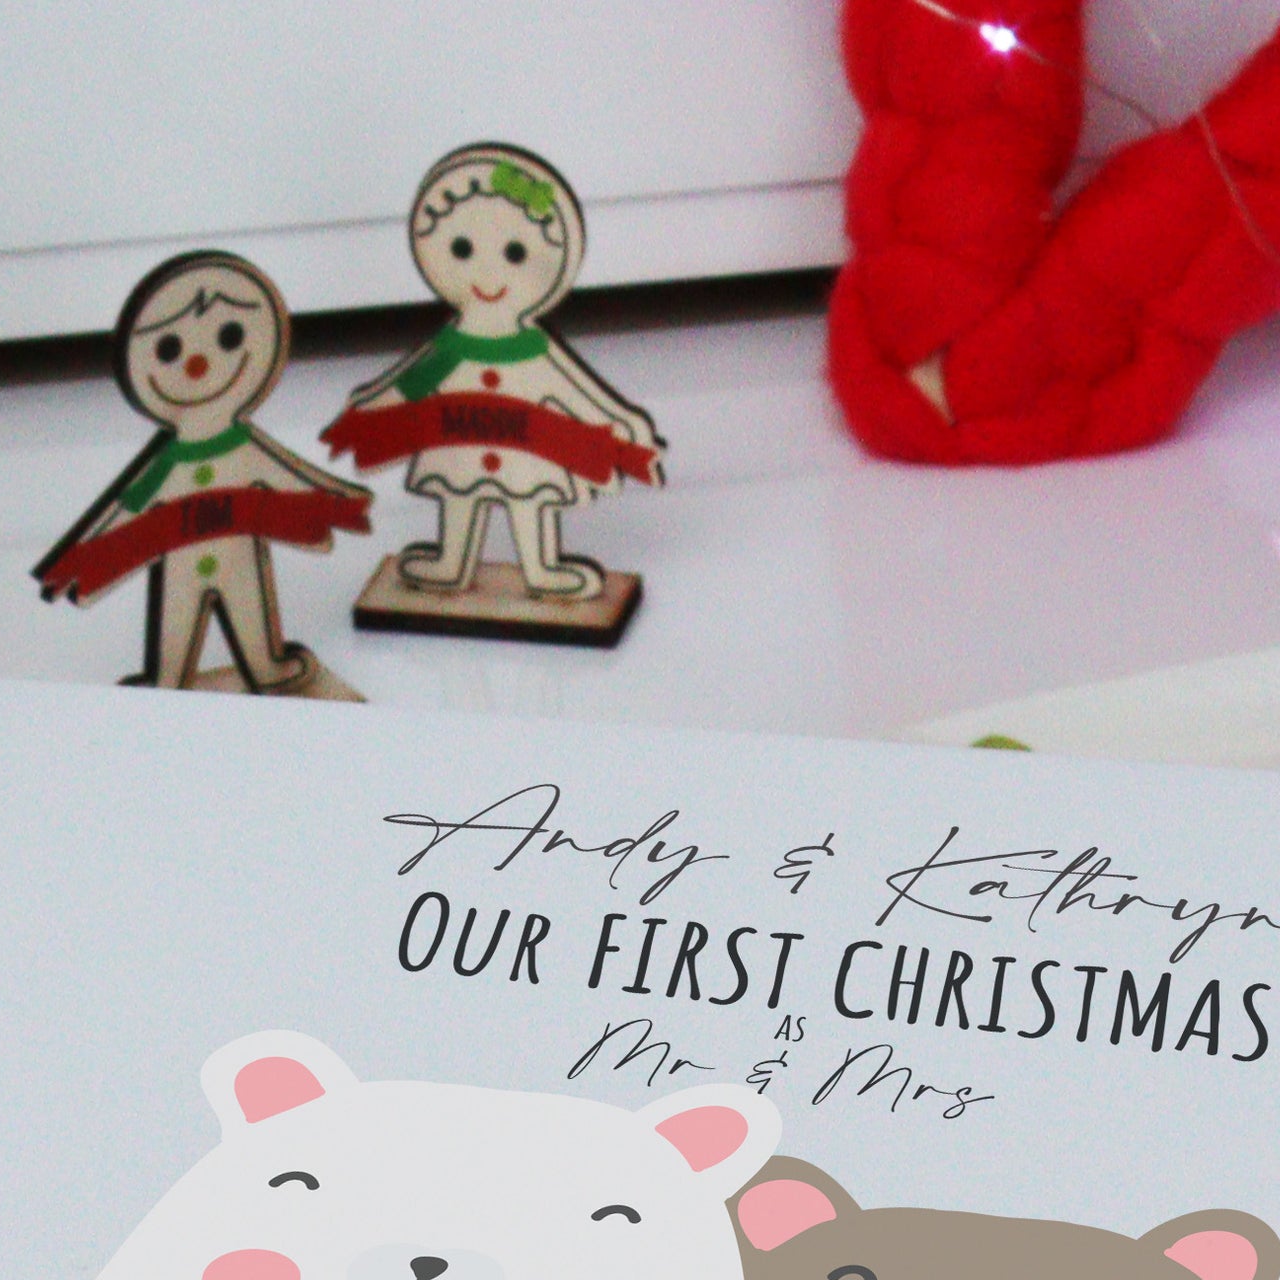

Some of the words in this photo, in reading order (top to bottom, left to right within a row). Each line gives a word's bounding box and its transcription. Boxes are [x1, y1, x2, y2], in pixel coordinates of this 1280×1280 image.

[382, 783, 730, 906] Andy
[773, 832, 835, 895] &
[398, 891, 550, 985] OUR
[587, 913, 805, 1010] FIRST
[834, 940, 1272, 1062] CHRISTMAS
[773, 1014, 807, 1043] AS
[567, 1018, 716, 1087] Mr
[745, 1050, 788, 1095] &
[811, 1044, 996, 1120] Mrs
